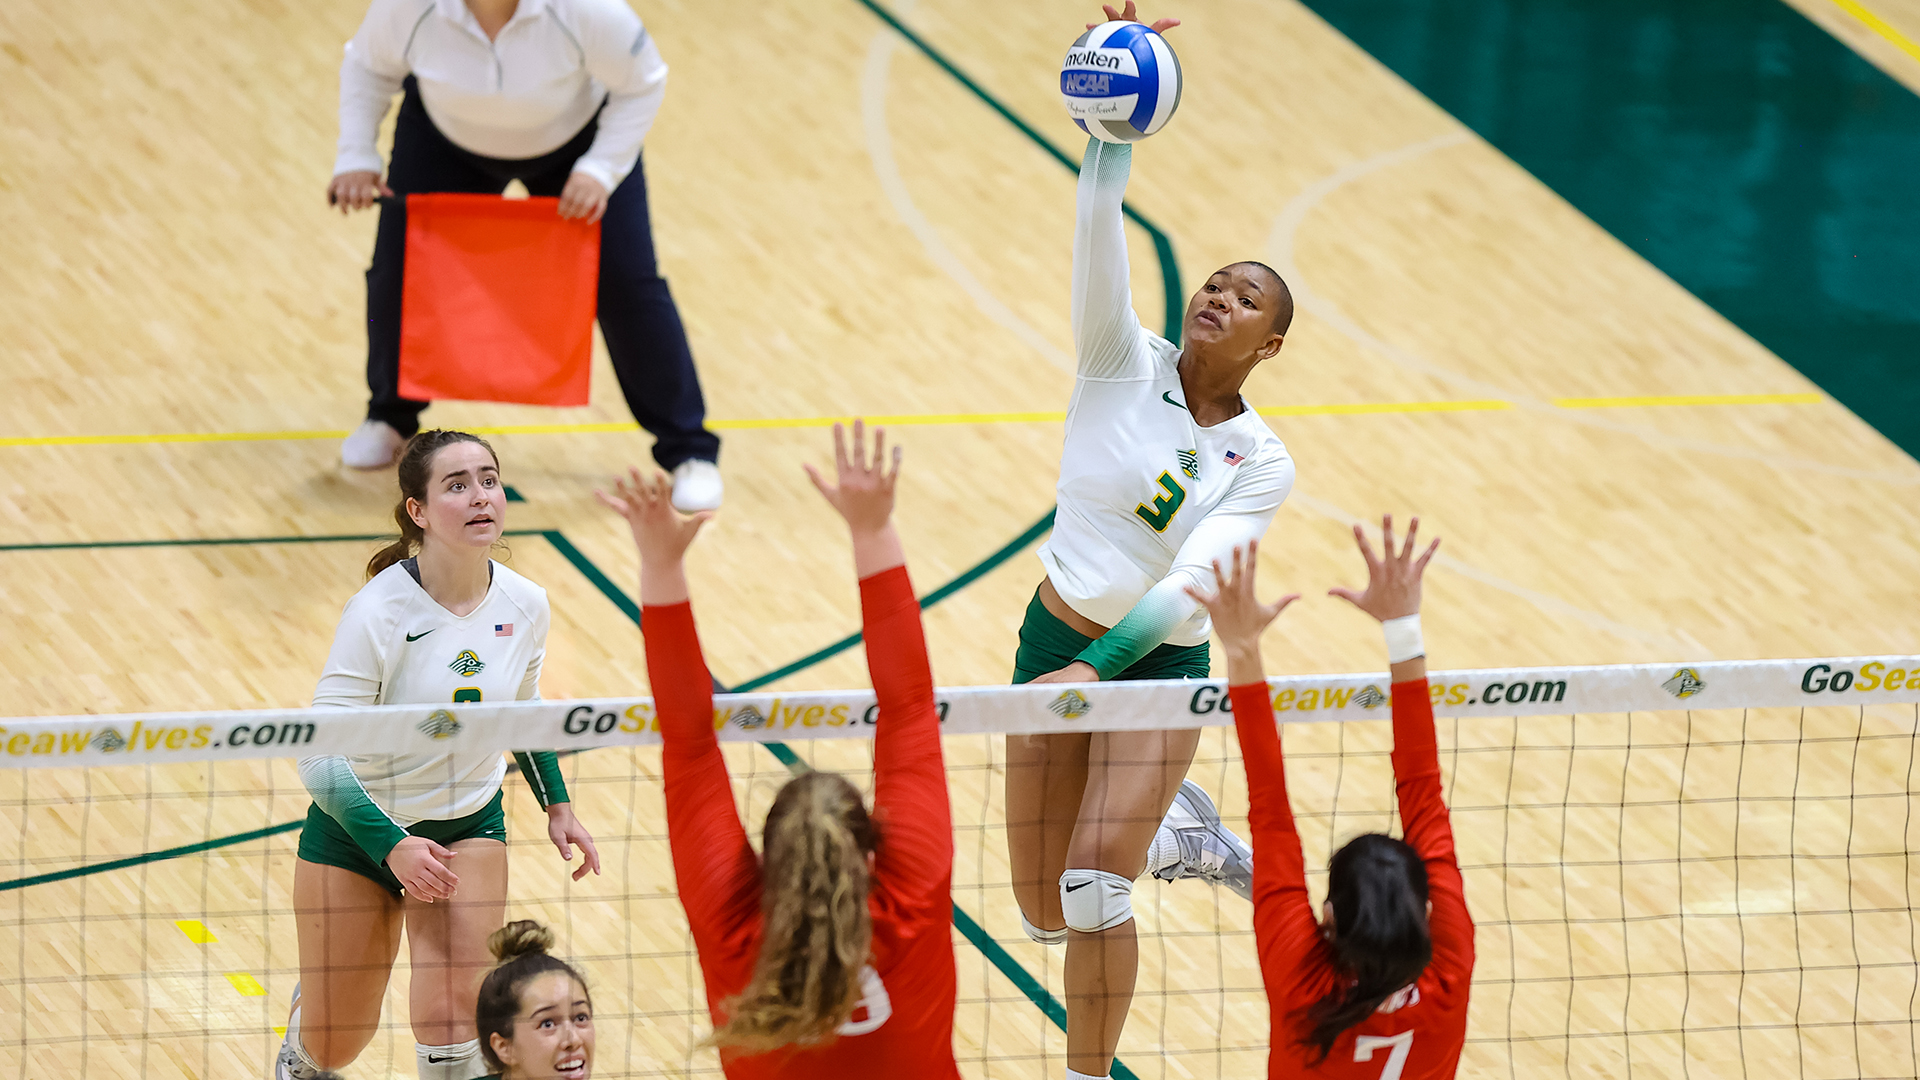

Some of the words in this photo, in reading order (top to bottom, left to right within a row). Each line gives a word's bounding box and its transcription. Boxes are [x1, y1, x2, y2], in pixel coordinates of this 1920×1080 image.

[1065, 51, 1120, 70] molten
[1066, 73, 1110, 95] NCAA
[1134, 469, 1187, 533] 3
[0, 720, 316, 756] eawolves.com
[1353, 1029, 1415, 1080] 7
